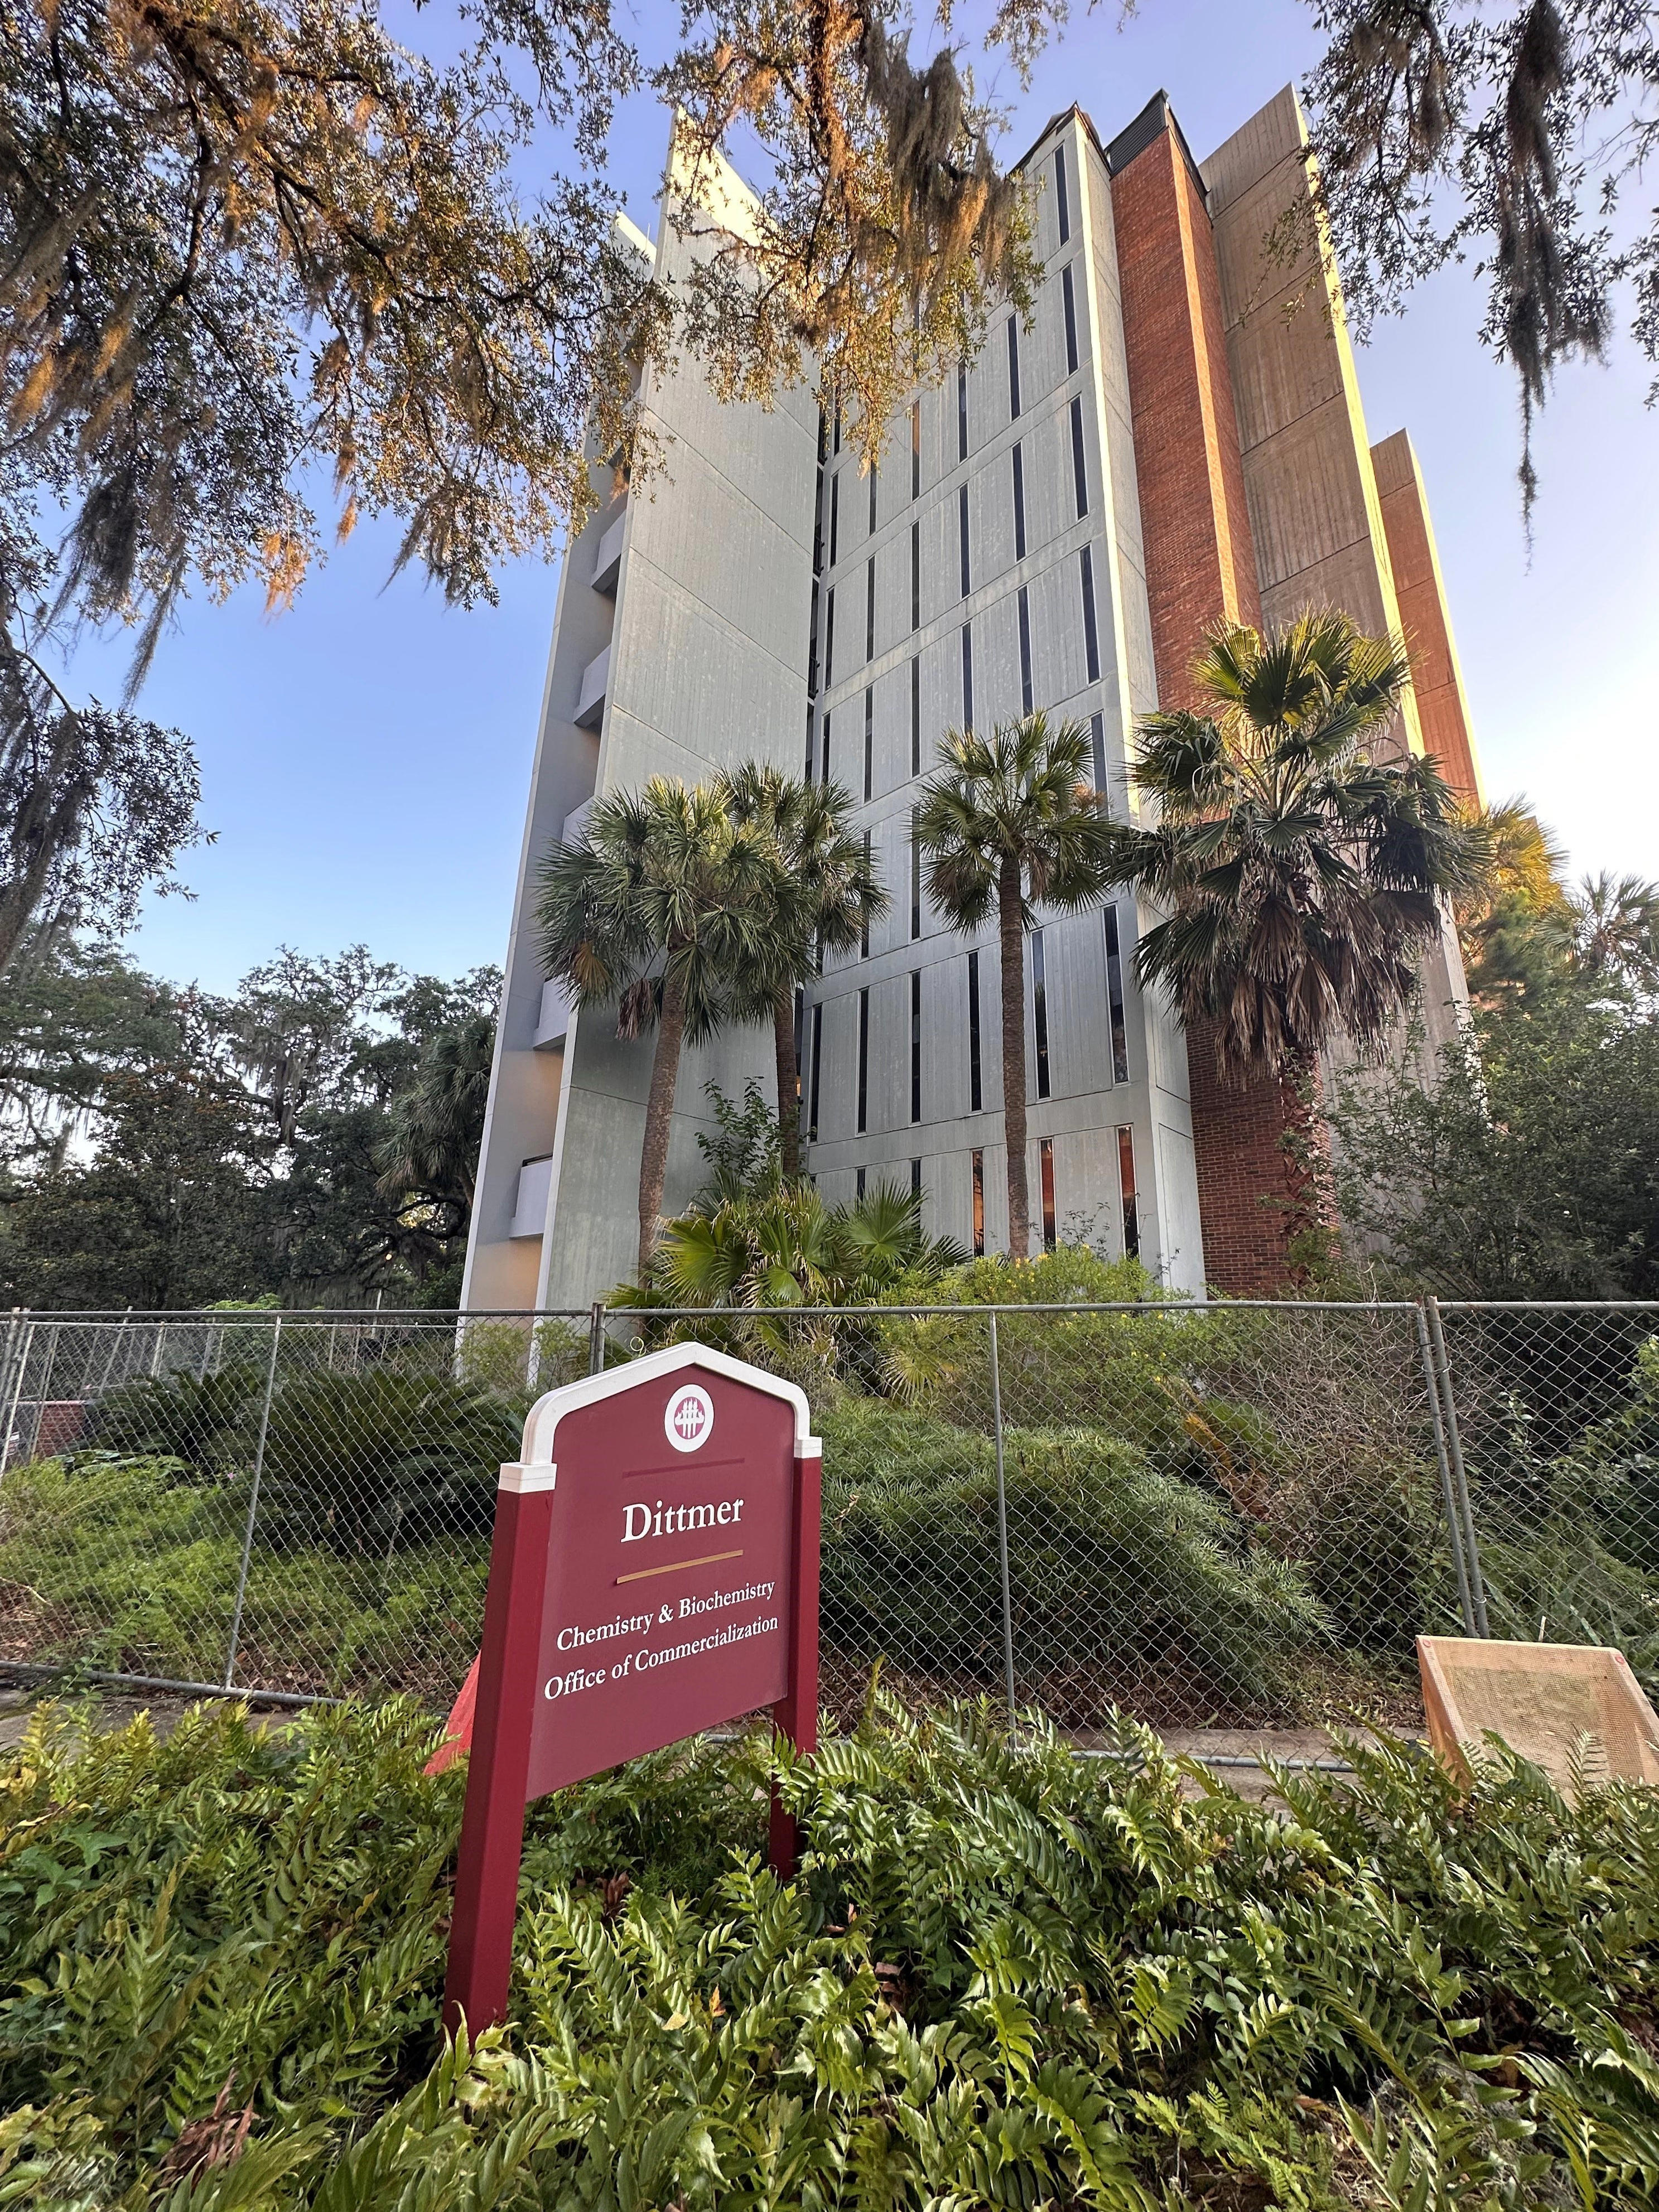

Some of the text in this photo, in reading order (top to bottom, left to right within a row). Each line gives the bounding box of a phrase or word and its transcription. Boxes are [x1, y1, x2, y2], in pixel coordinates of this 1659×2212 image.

[620, 1499, 744, 1543] Dittmer
[557, 1581, 775, 1651] Chemistry & Biochemistry
[544, 1617, 778, 1700] Office of Commercialization
